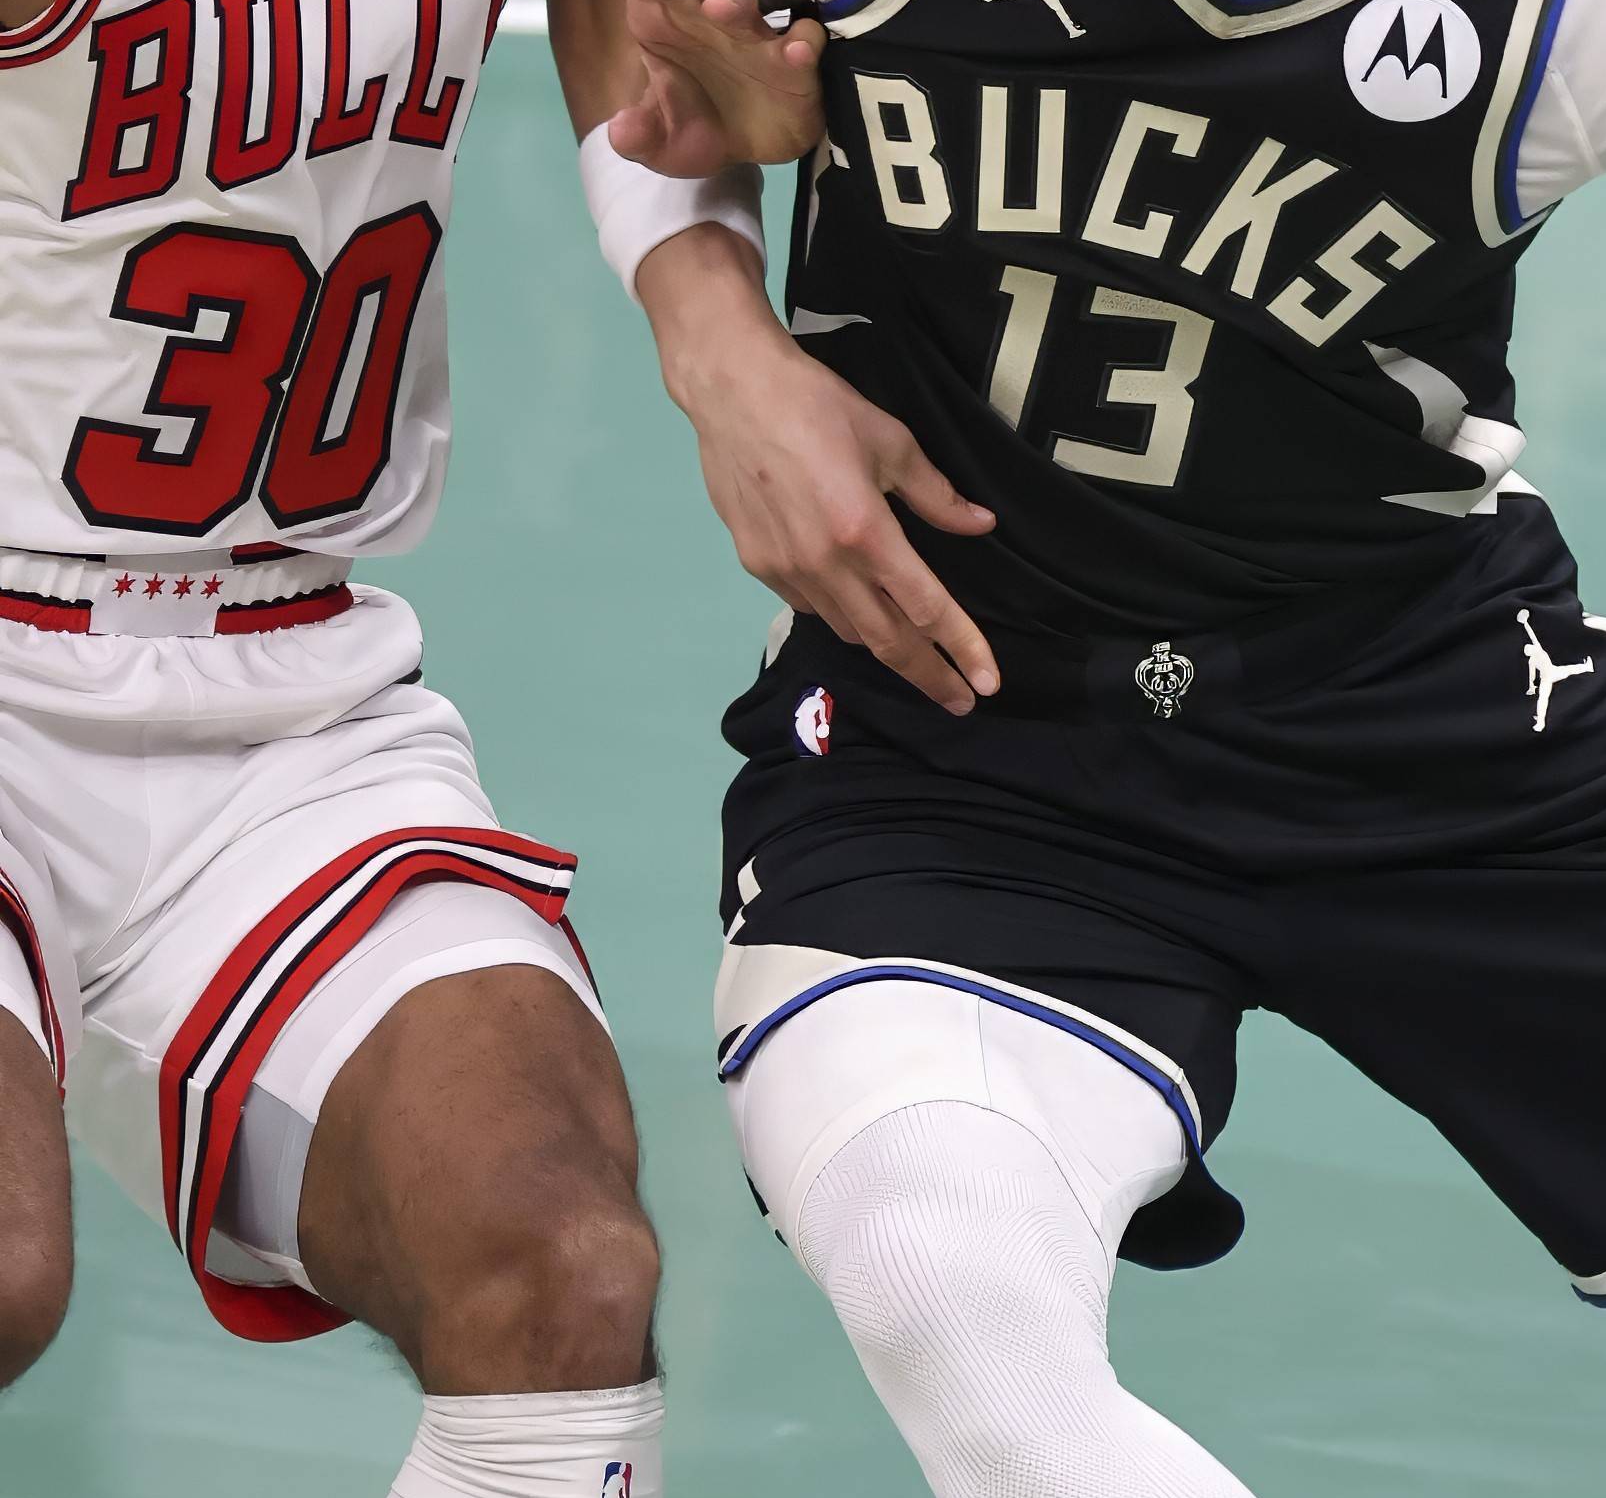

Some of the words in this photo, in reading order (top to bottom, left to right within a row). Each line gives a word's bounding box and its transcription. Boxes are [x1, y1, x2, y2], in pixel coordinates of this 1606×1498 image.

[854, 72, 1437, 348] BUCKS
[61, 200, 444, 538] 30
[989, 264, 1215, 487] 13
